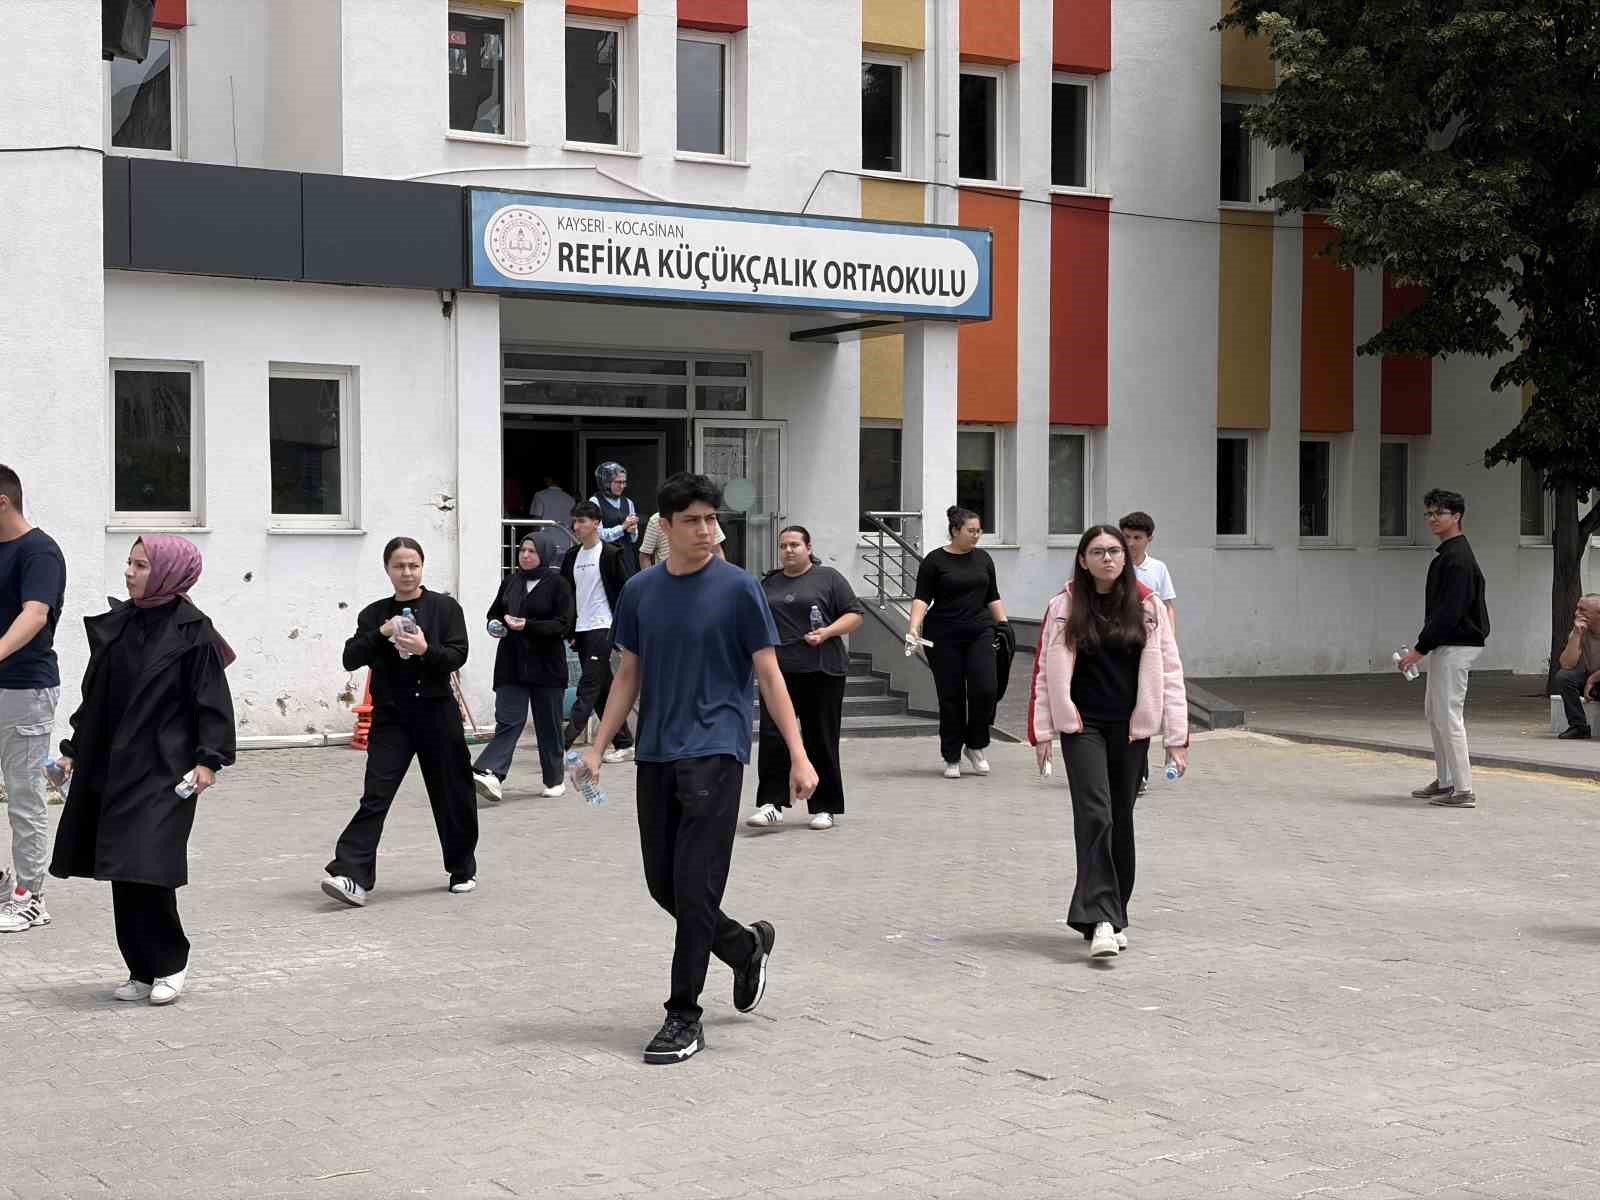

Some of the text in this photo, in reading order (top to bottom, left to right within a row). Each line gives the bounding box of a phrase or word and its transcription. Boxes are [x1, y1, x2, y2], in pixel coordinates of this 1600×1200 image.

[557, 216, 605, 233] KAYSERİ
[615, 220, 684, 239] KOCASİNAN
[558, 238, 651, 277] REFİKA
[658, 243, 818, 292] KÜÇÜKÇALIK
[823, 260, 966, 298] ORTAOKULU
